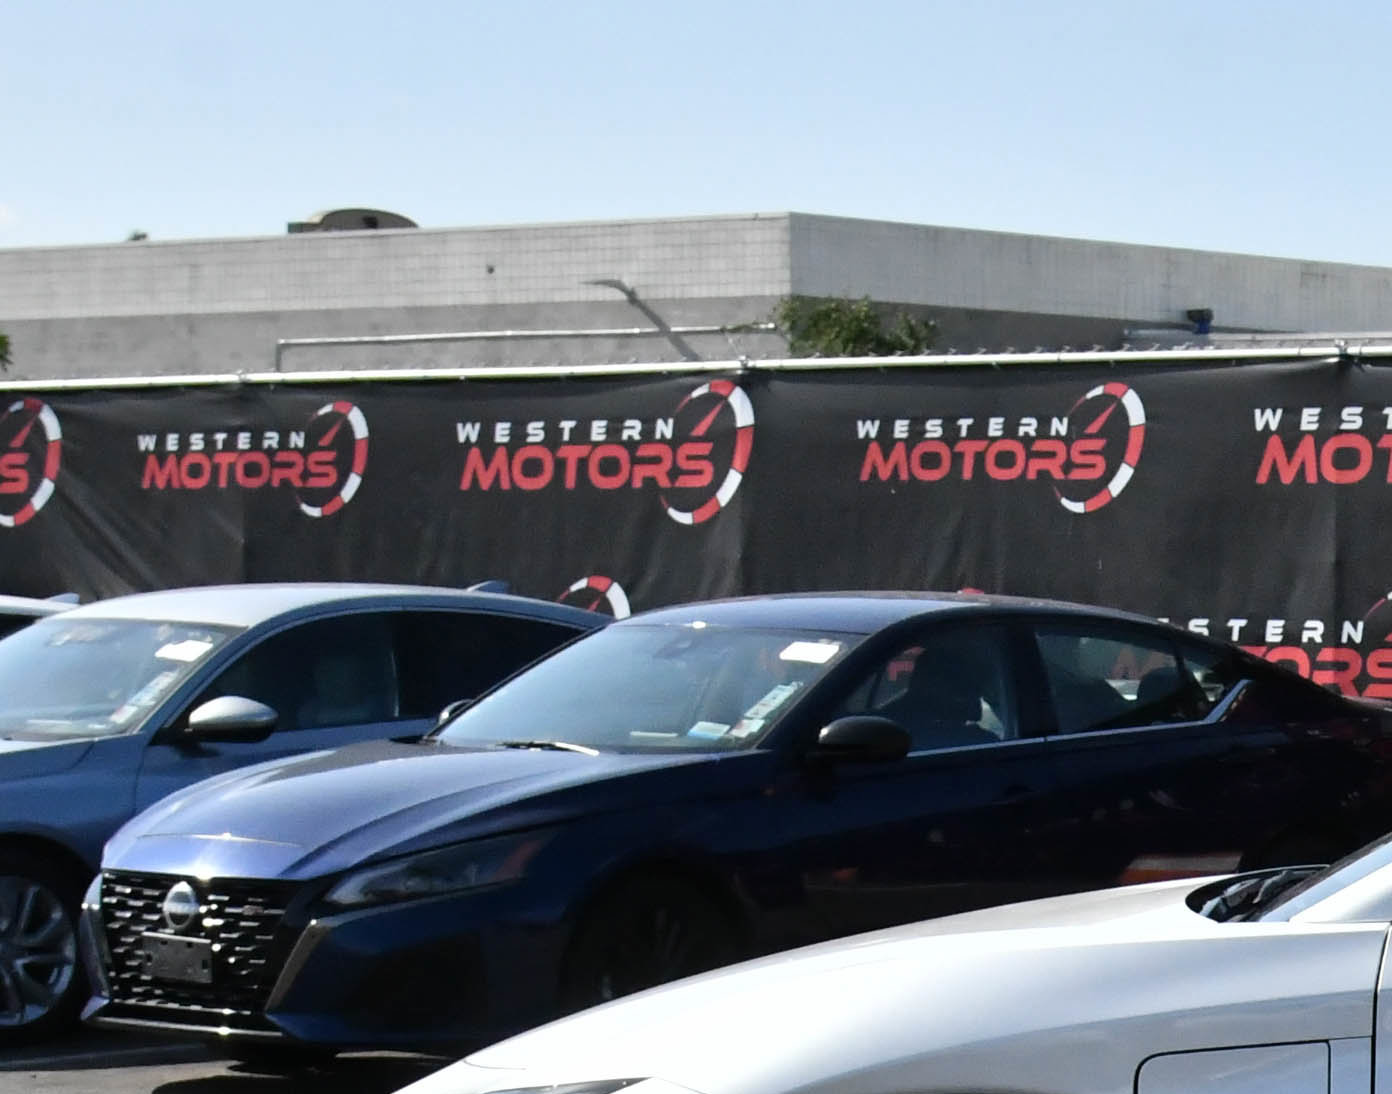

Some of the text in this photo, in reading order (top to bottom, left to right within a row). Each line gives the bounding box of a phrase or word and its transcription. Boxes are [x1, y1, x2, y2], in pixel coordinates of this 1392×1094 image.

[456, 417, 674, 443] WESTERN
[857, 416, 1069, 439] WESTERN
[138, 431, 305, 452] WESTERN
[141, 450, 339, 491] MOTORS
[459, 441, 715, 492] MOTORS
[860, 437, 1108, 482] MOTORS
[1158, 617, 1364, 644] STERN
